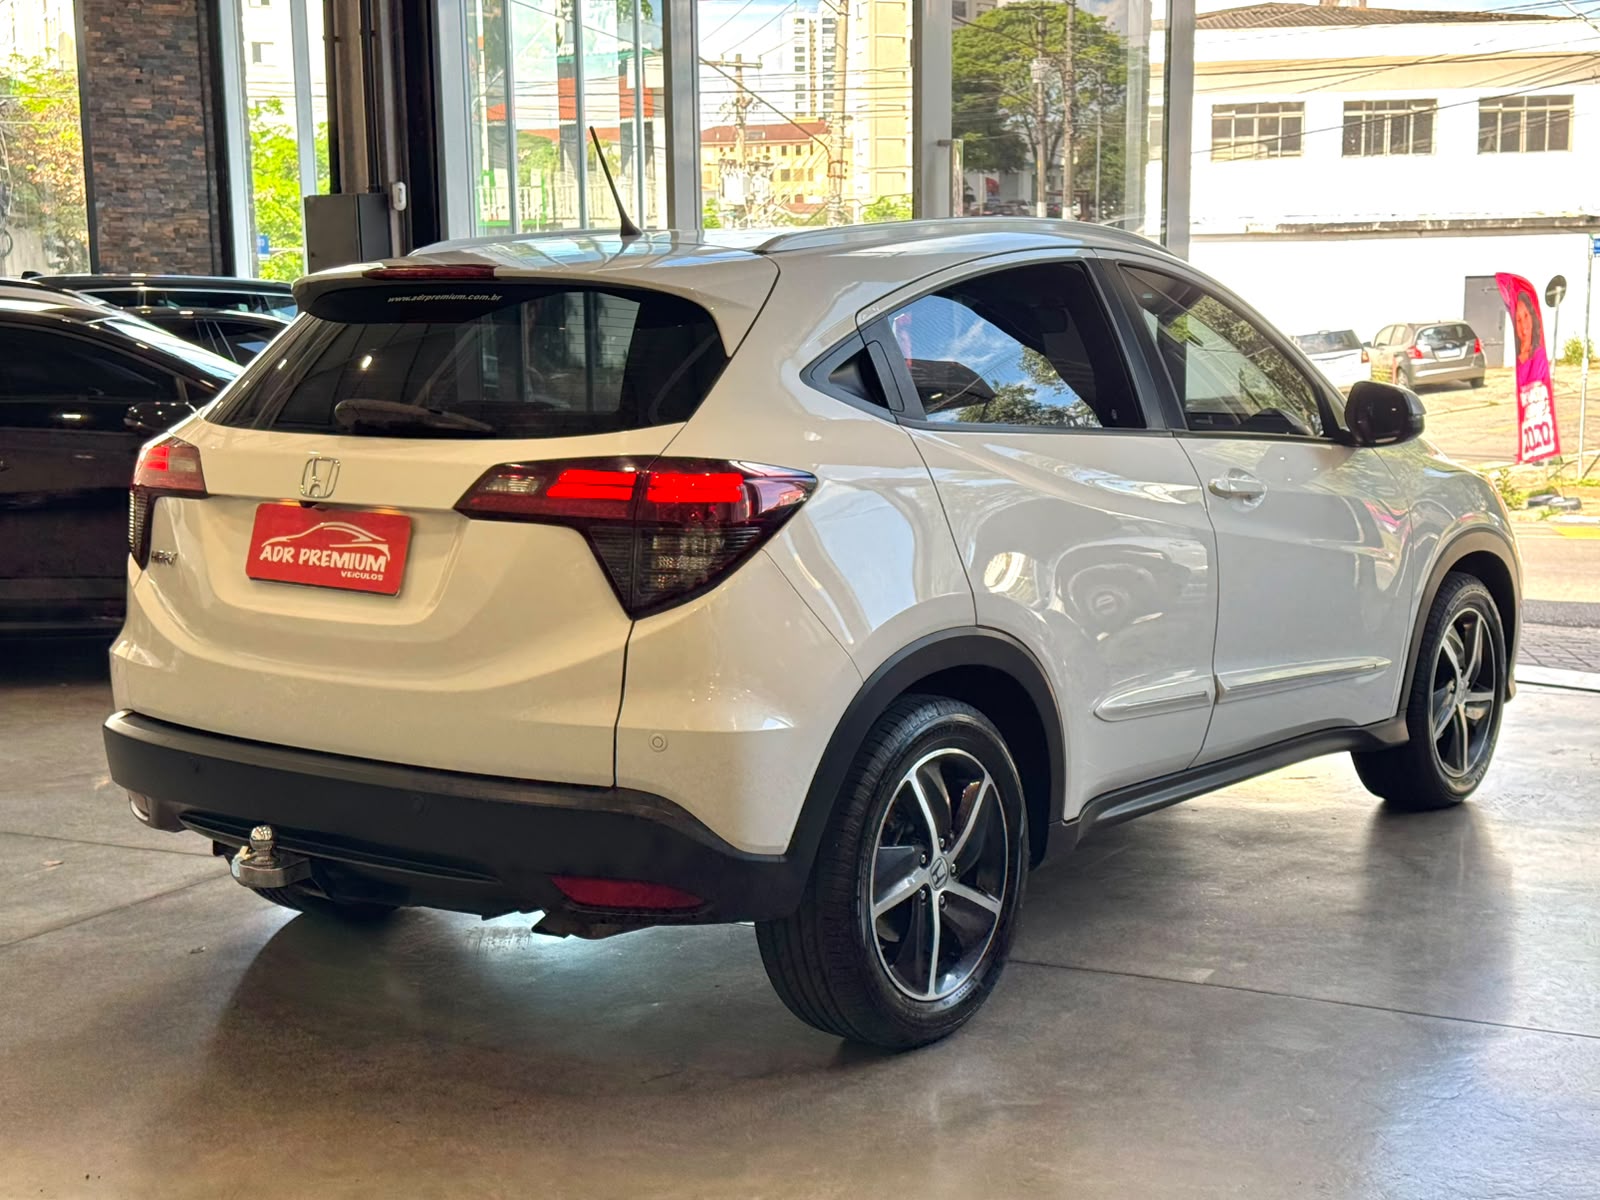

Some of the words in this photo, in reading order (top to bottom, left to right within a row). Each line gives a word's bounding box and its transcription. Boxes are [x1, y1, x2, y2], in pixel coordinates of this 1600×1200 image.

[387, 294, 502, 303] www.adrpremium.com.br
[260, 545, 294, 563] ADR
[298, 548, 385, 573] PREMIUM
